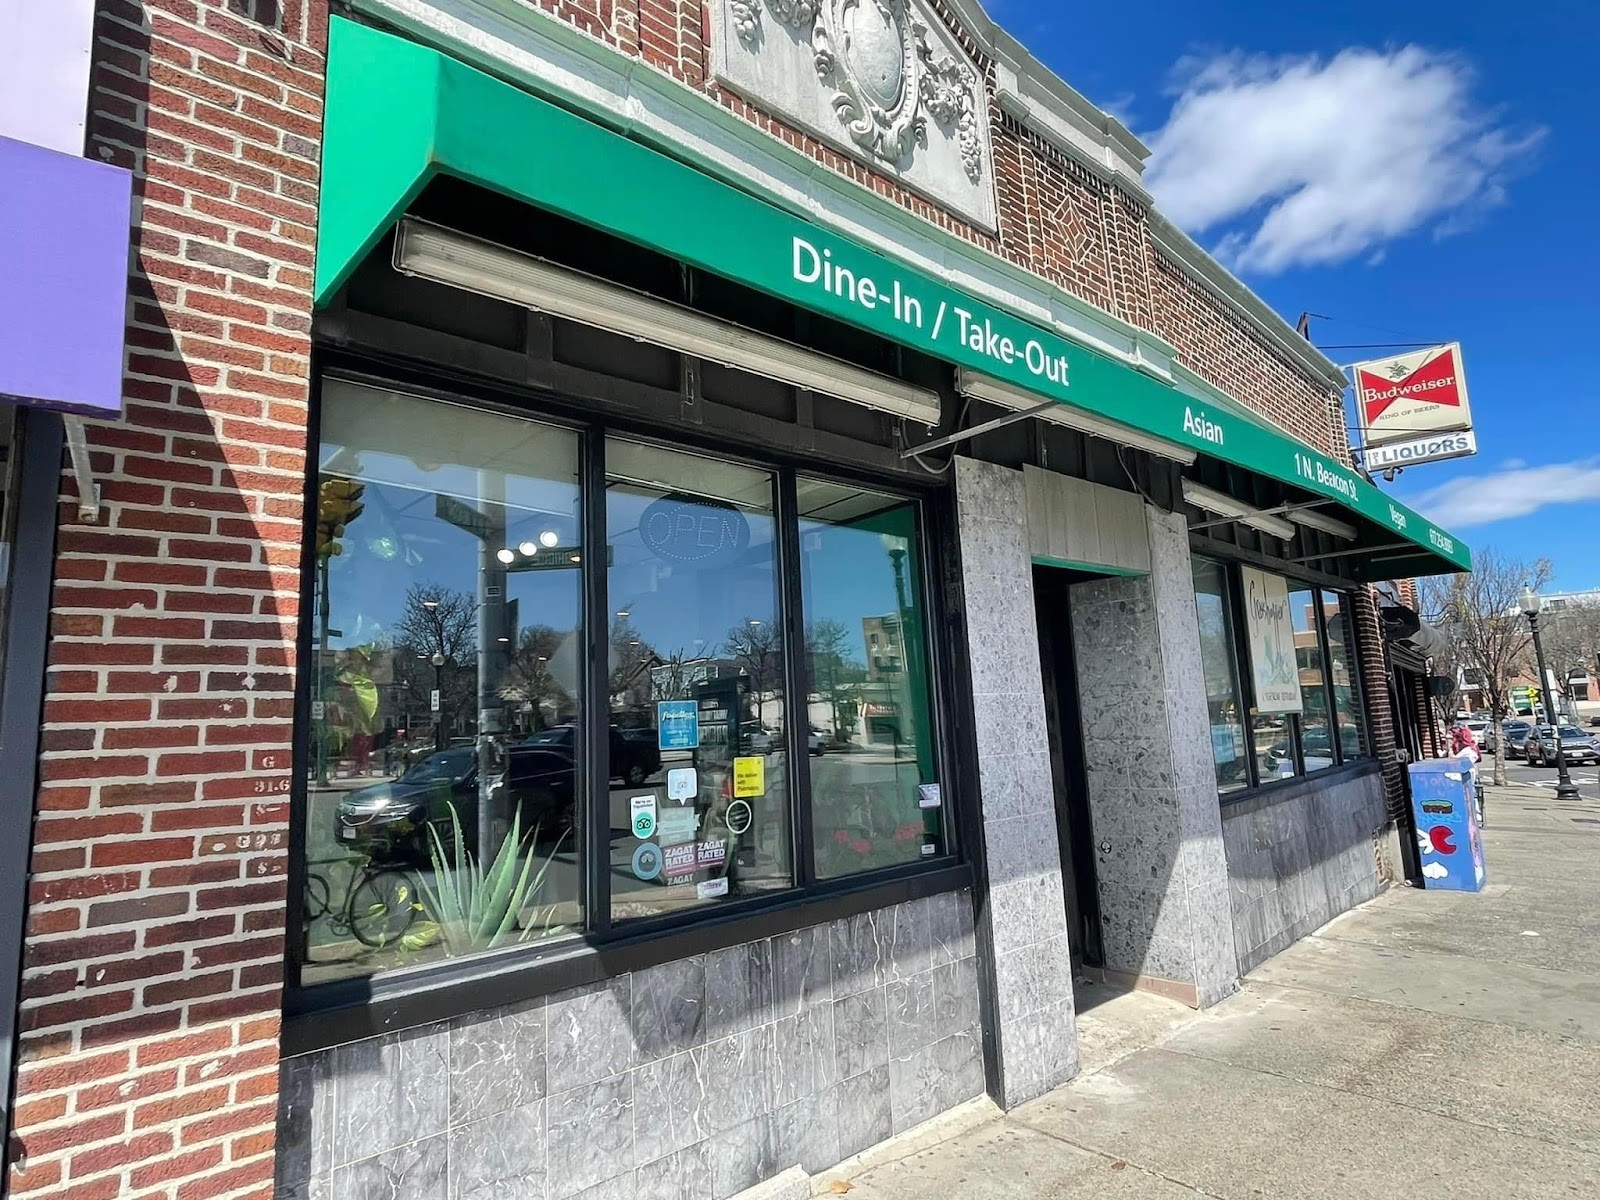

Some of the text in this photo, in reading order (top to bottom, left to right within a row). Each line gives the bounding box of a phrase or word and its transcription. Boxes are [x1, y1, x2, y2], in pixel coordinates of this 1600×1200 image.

[792, 236, 1069, 386] Dine-In / Take-Out
[1363, 376, 1456, 402] Budweiser
[1379, 412, 1399, 420] KING
[1414, 404, 1440, 413] BEERS
[1183, 406, 1223, 445] Asian
[1382, 437, 1468, 461] LIQUORS
[1294, 453, 1358, 501] 1 N. Beacon St.
[1389, 503, 1406, 530] Vegan
[648, 512, 740, 550] OPEN
[665, 845, 694, 858] ZAGAT
[697, 840, 726, 851] ZAGAT
[697, 849, 726, 860] RATED
[665, 854, 695, 867] RATED
[667, 874, 694, 886] ZAGAT
